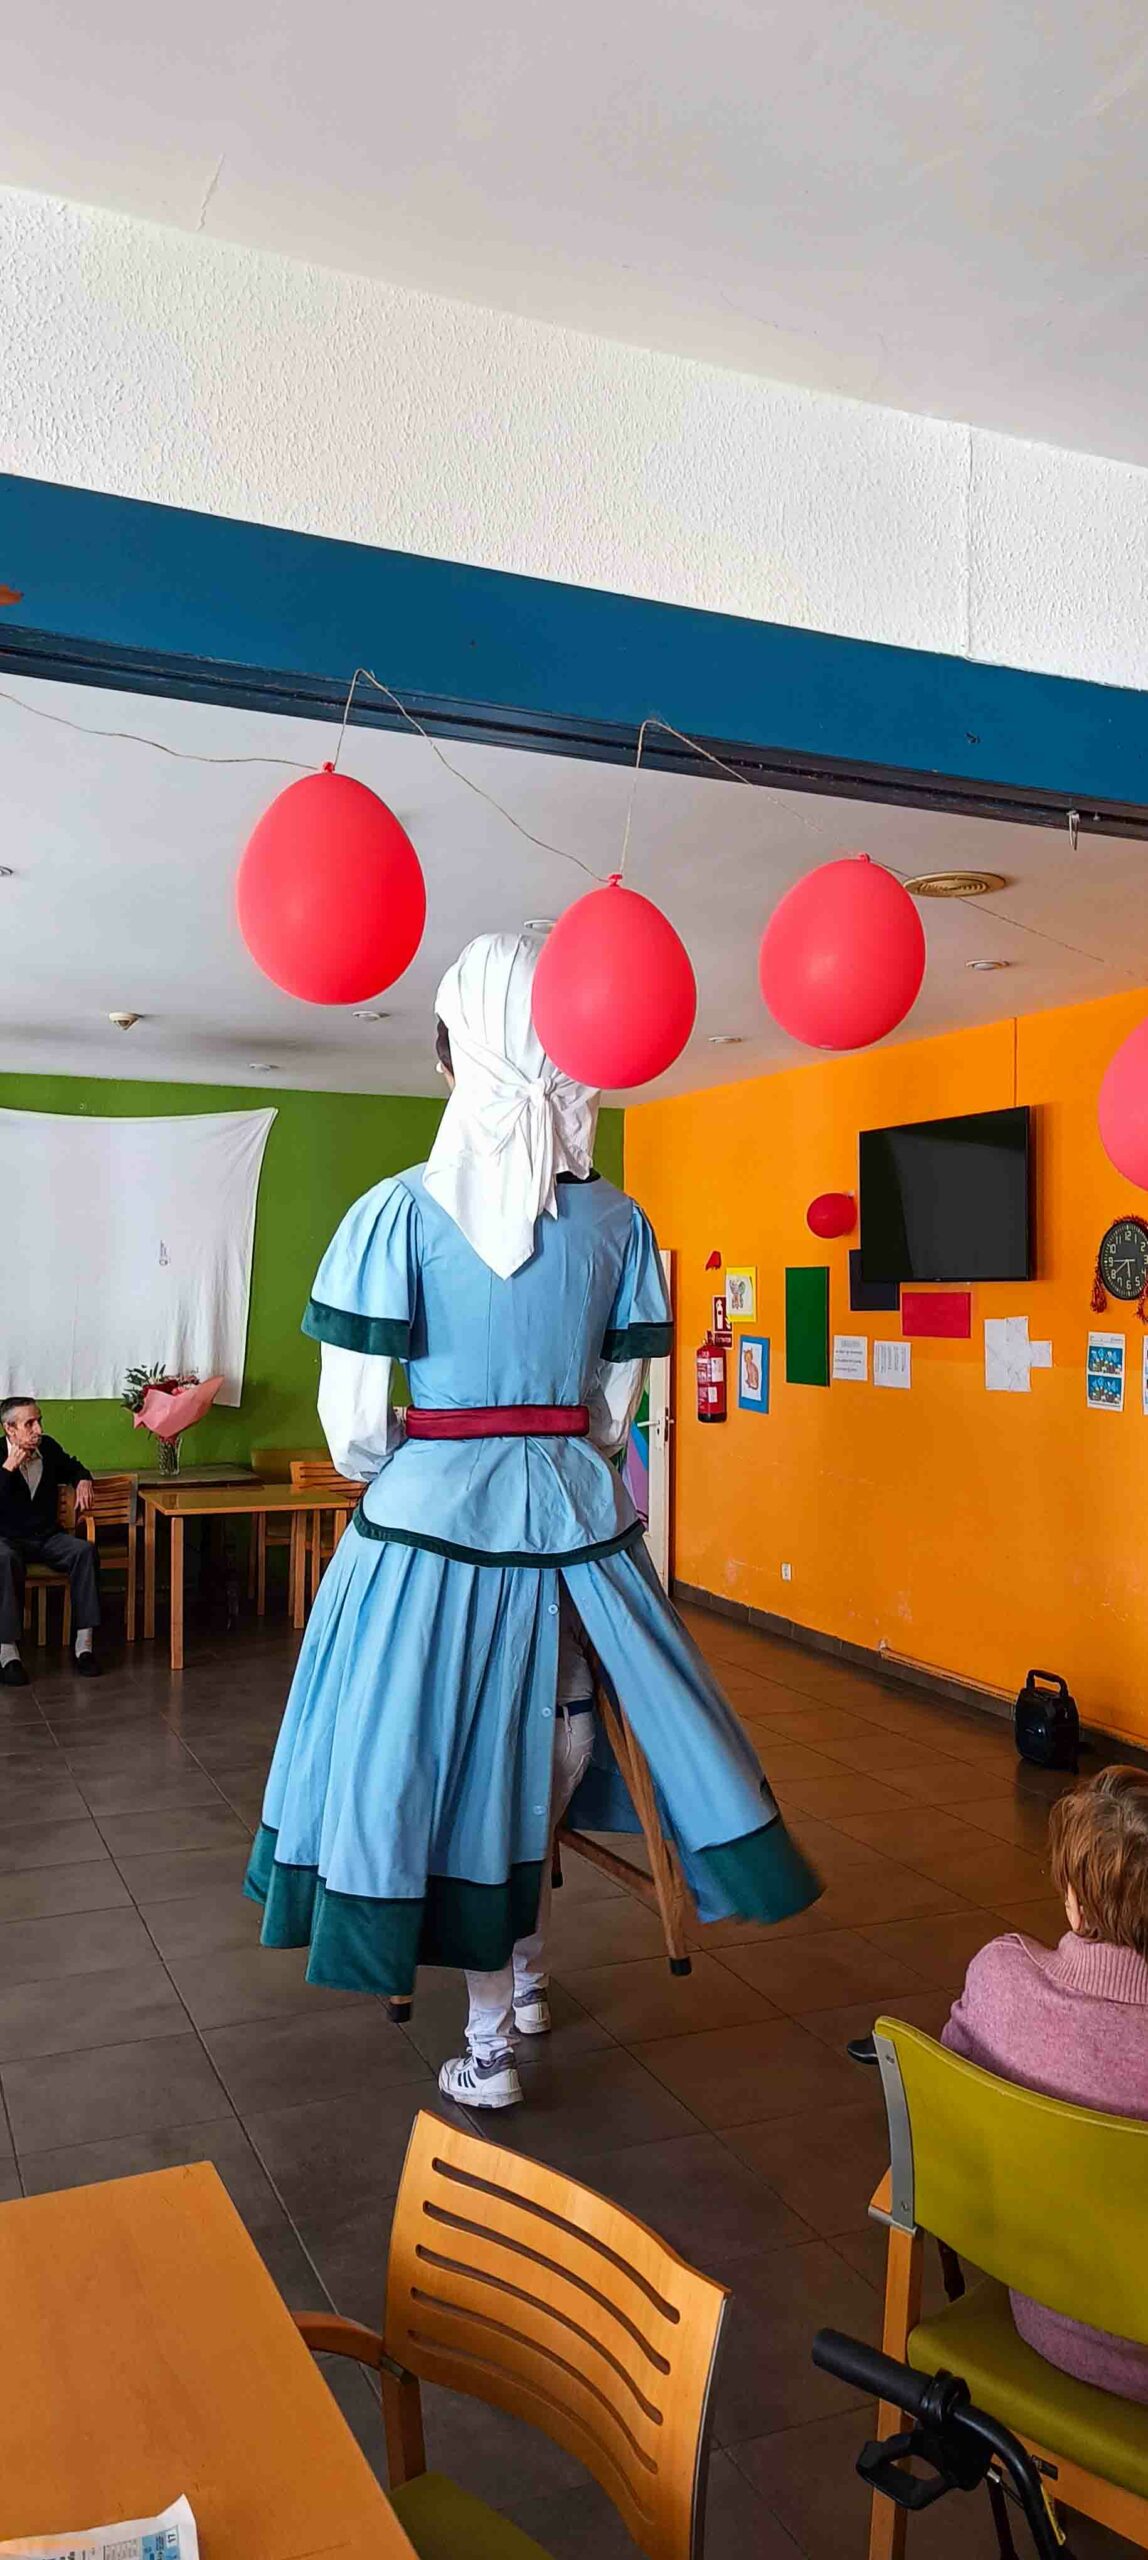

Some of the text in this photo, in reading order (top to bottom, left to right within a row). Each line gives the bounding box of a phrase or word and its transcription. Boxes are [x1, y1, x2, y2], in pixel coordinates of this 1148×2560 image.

[1116, 1236, 1122, 1245] 11
[1125, 1231, 1131, 1241] 12
[1110, 1244, 1116, 1254] 10
[1140, 1242, 1146, 1252] 2
[1108, 1257, 1113, 1267] 9
[1144, 1255, 1148, 1265] 3
[1110, 1270, 1116, 1279] 8
[1141, 1268, 1147, 1278] 4
[1117, 1277, 1122, 1286] 7
[1126, 1280, 1131, 1290] 6
[1135, 1276, 1140, 1287] 5
